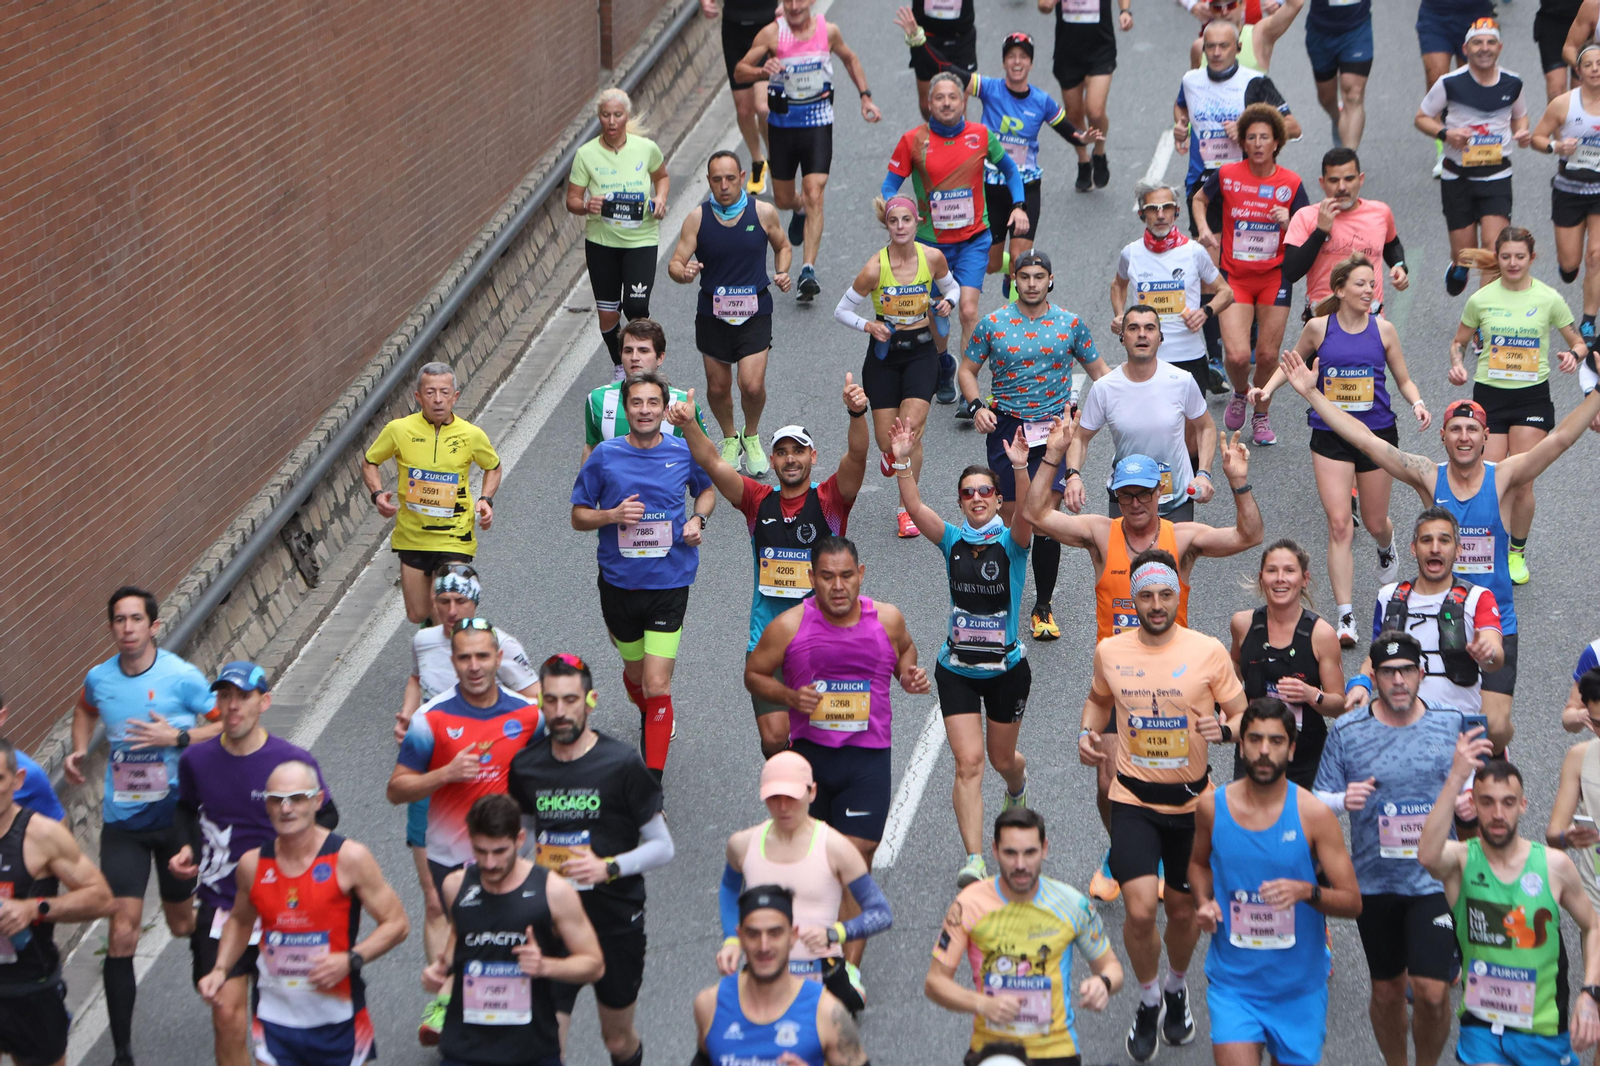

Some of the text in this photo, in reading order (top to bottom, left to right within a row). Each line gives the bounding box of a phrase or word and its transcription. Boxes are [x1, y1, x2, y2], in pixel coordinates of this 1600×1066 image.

[944, 190, 968, 199] ZURICH
[1250, 221, 1275, 230] ZURICH
[899, 286, 924, 294] ZURICH
[1153, 281, 1180, 290] ZURICH
[1153, 296, 1169, 304] 4981
[1507, 338, 1535, 347] ZURICH
[1505, 352, 1523, 361] 3706
[1339, 367, 1368, 377] ZURICH
[1339, 383, 1357, 391] 3820
[1336, 394, 1361, 402] ISABELLE
[424, 472, 453, 481] ZURICH
[422, 486, 439, 495] 5591
[419, 497, 440, 507] PASCAL
[642, 512, 666, 521] URICH
[635, 527, 654, 536] 7885
[1458, 527, 1488, 537] ZURICH
[1461, 543, 1476, 552] 437
[777, 551, 807, 559] ZURICH
[1468, 555, 1491, 563] FRATER
[775, 566, 794, 575] 4205
[774, 579, 796, 587] NOLETE
[954, 582, 976, 593] LAURUS
[969, 620, 999, 628] ZURICH
[831, 682, 864, 691] ZURICH
[1121, 688, 1151, 697] Maratón
[830, 699, 850, 708] 5268
[1146, 719, 1181, 729] ZURICH
[1146, 736, 1167, 745] 4134
[126, 753, 158, 762] ZURICH
[566, 788, 600, 797] AMERICA
[536, 794, 601, 812] CHICAGO
[1400, 801, 1435, 814] ZURICH
[538, 811, 585, 820] MARATHON
[548, 832, 582, 845] ZURICH
[1250, 927, 1275, 936] PEDRO
[283, 933, 322, 945] ZURICH
[465, 931, 526, 947] CAPACITY
[484, 964, 521, 977] ZURICH
[788, 962, 814, 973] RICH
[1490, 966, 1529, 981] ZURICH
[1006, 977, 1045, 990] ZURICH
